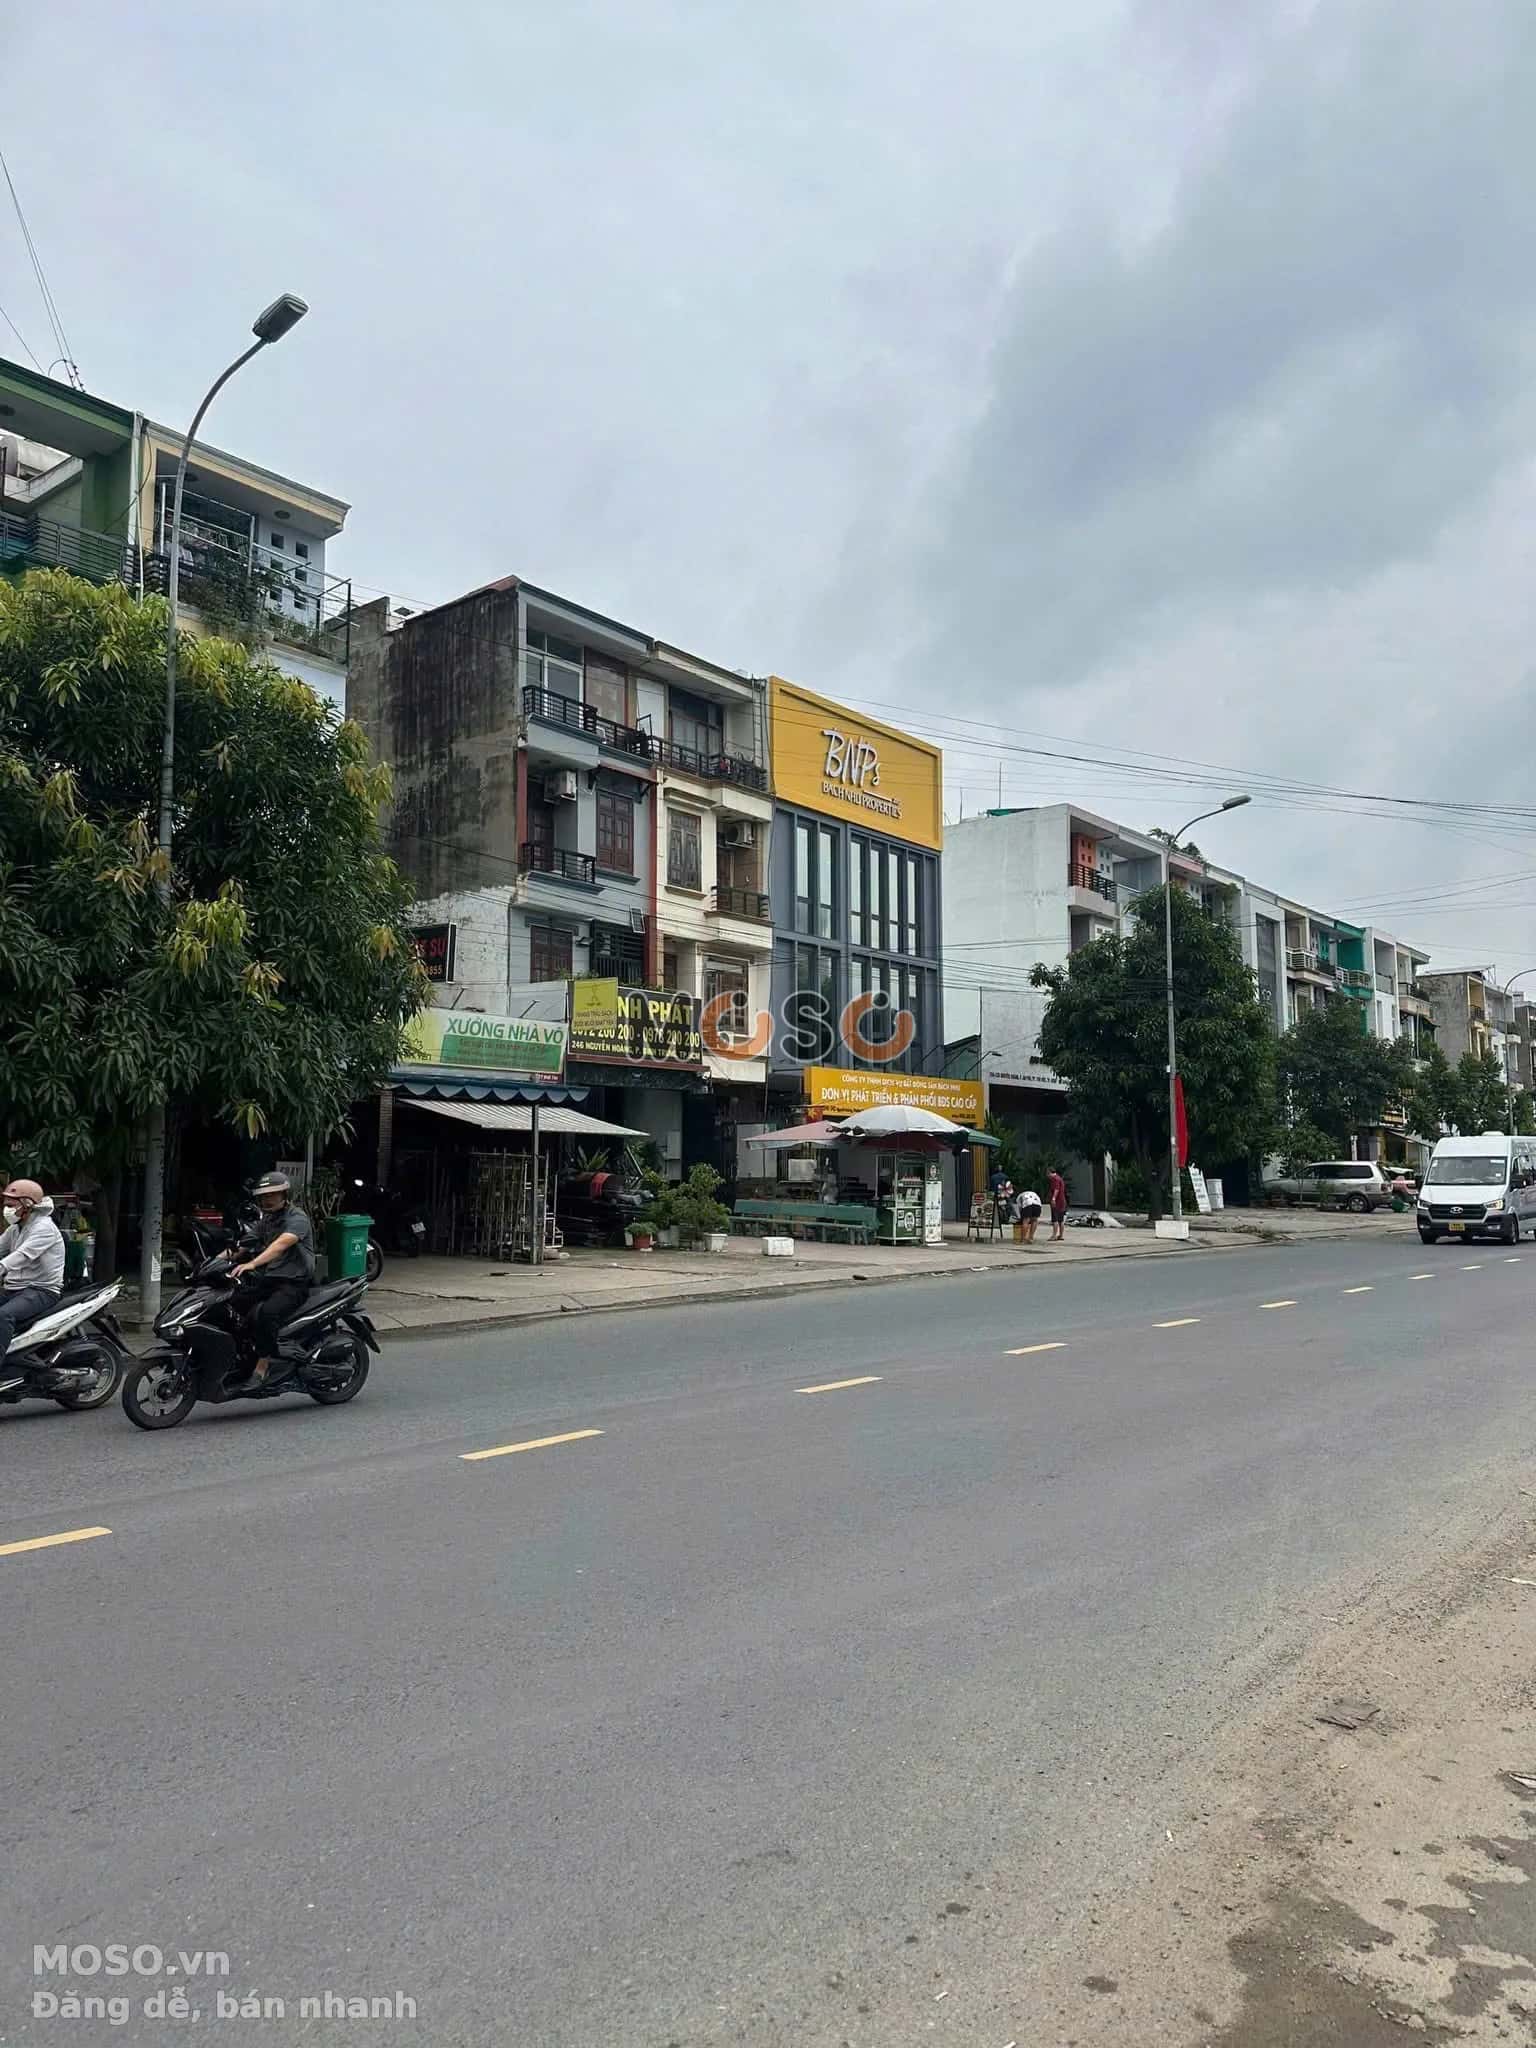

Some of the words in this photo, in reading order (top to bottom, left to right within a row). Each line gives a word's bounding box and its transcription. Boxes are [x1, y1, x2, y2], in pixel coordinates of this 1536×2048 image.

[618, 996, 641, 1019] NH
[447, 1016, 507, 1039] XƯỞNG
[507, 1023, 540, 1042] NHÀ
[617, 1023, 634, 1041] 200
[685, 1031, 700, 1048] 200
[850, 1087, 870, 1103] PHÁT
[950, 1095, 964, 1109] CAO
